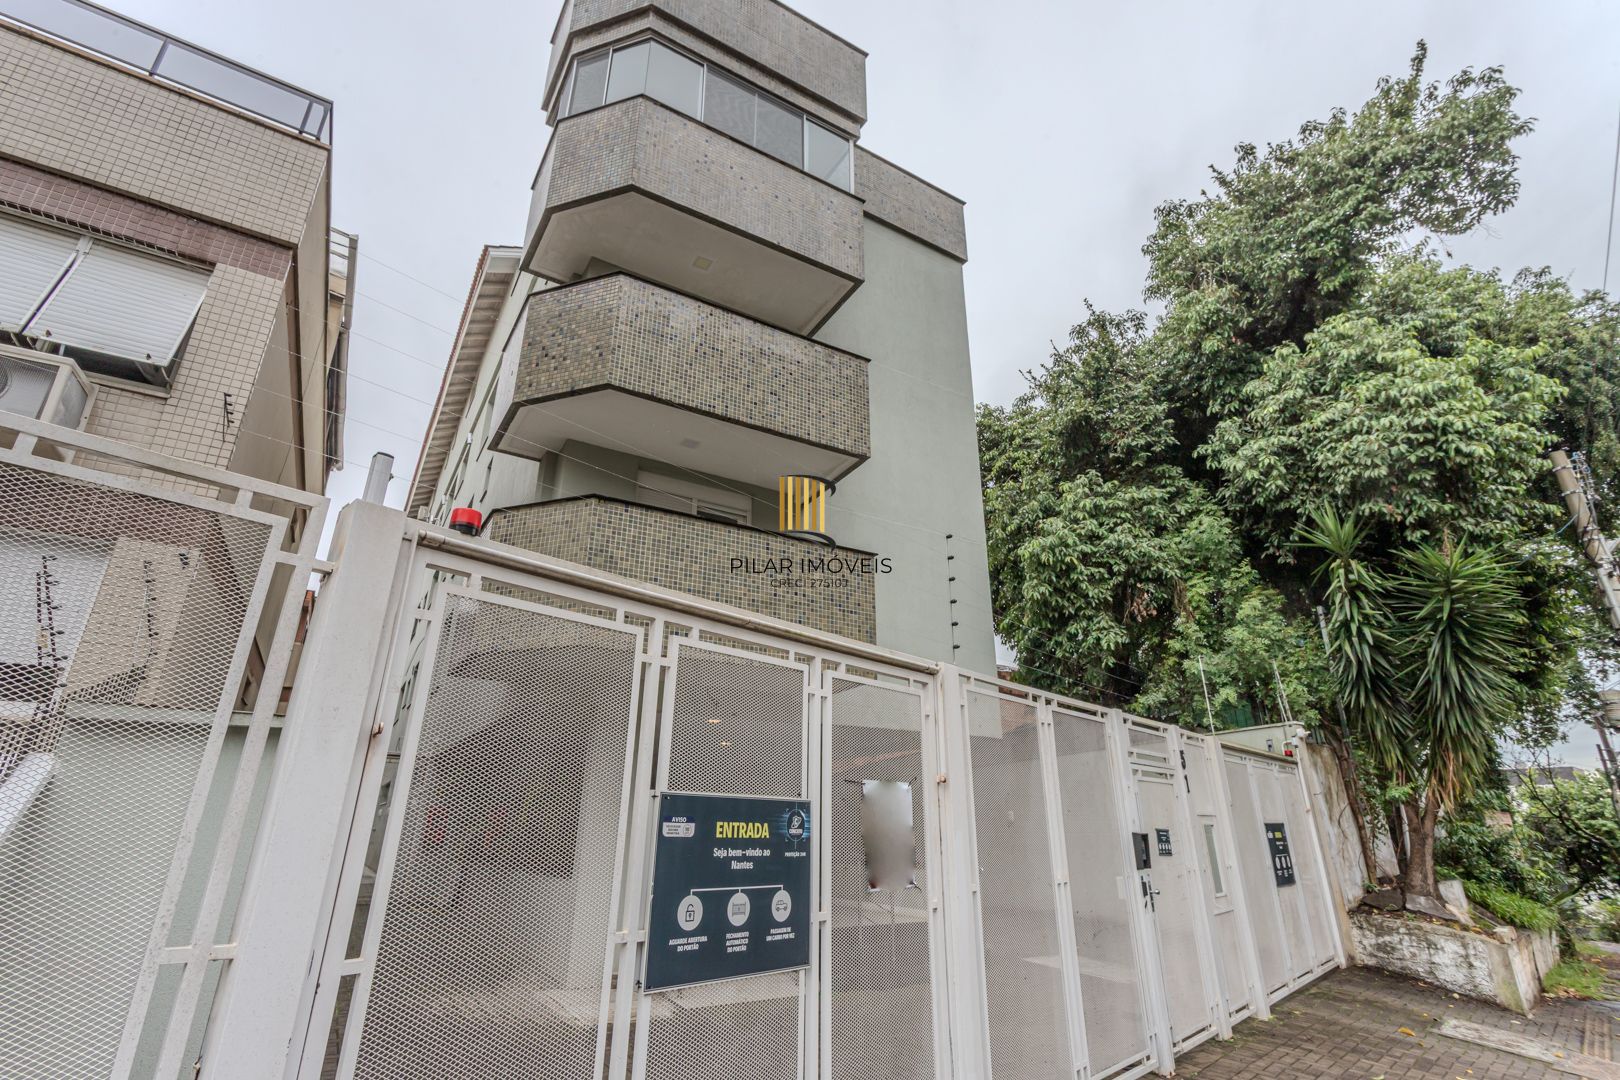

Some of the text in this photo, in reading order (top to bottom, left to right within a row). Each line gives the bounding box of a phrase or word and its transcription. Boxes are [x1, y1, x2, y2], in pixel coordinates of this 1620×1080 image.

[716, 821, 770, 839] ENTRADA
[713, 847, 771, 859] Seja bem-vindo ao
[731, 860, 754, 870] Nantes
[668, 935, 708, 946] AGUARDE ABERTURA
[725, 931, 750, 940] FECHAMENTO
[683, 943, 700, 951] PORTÃO
[725, 938, 749, 946] AUTOMÁTICO
